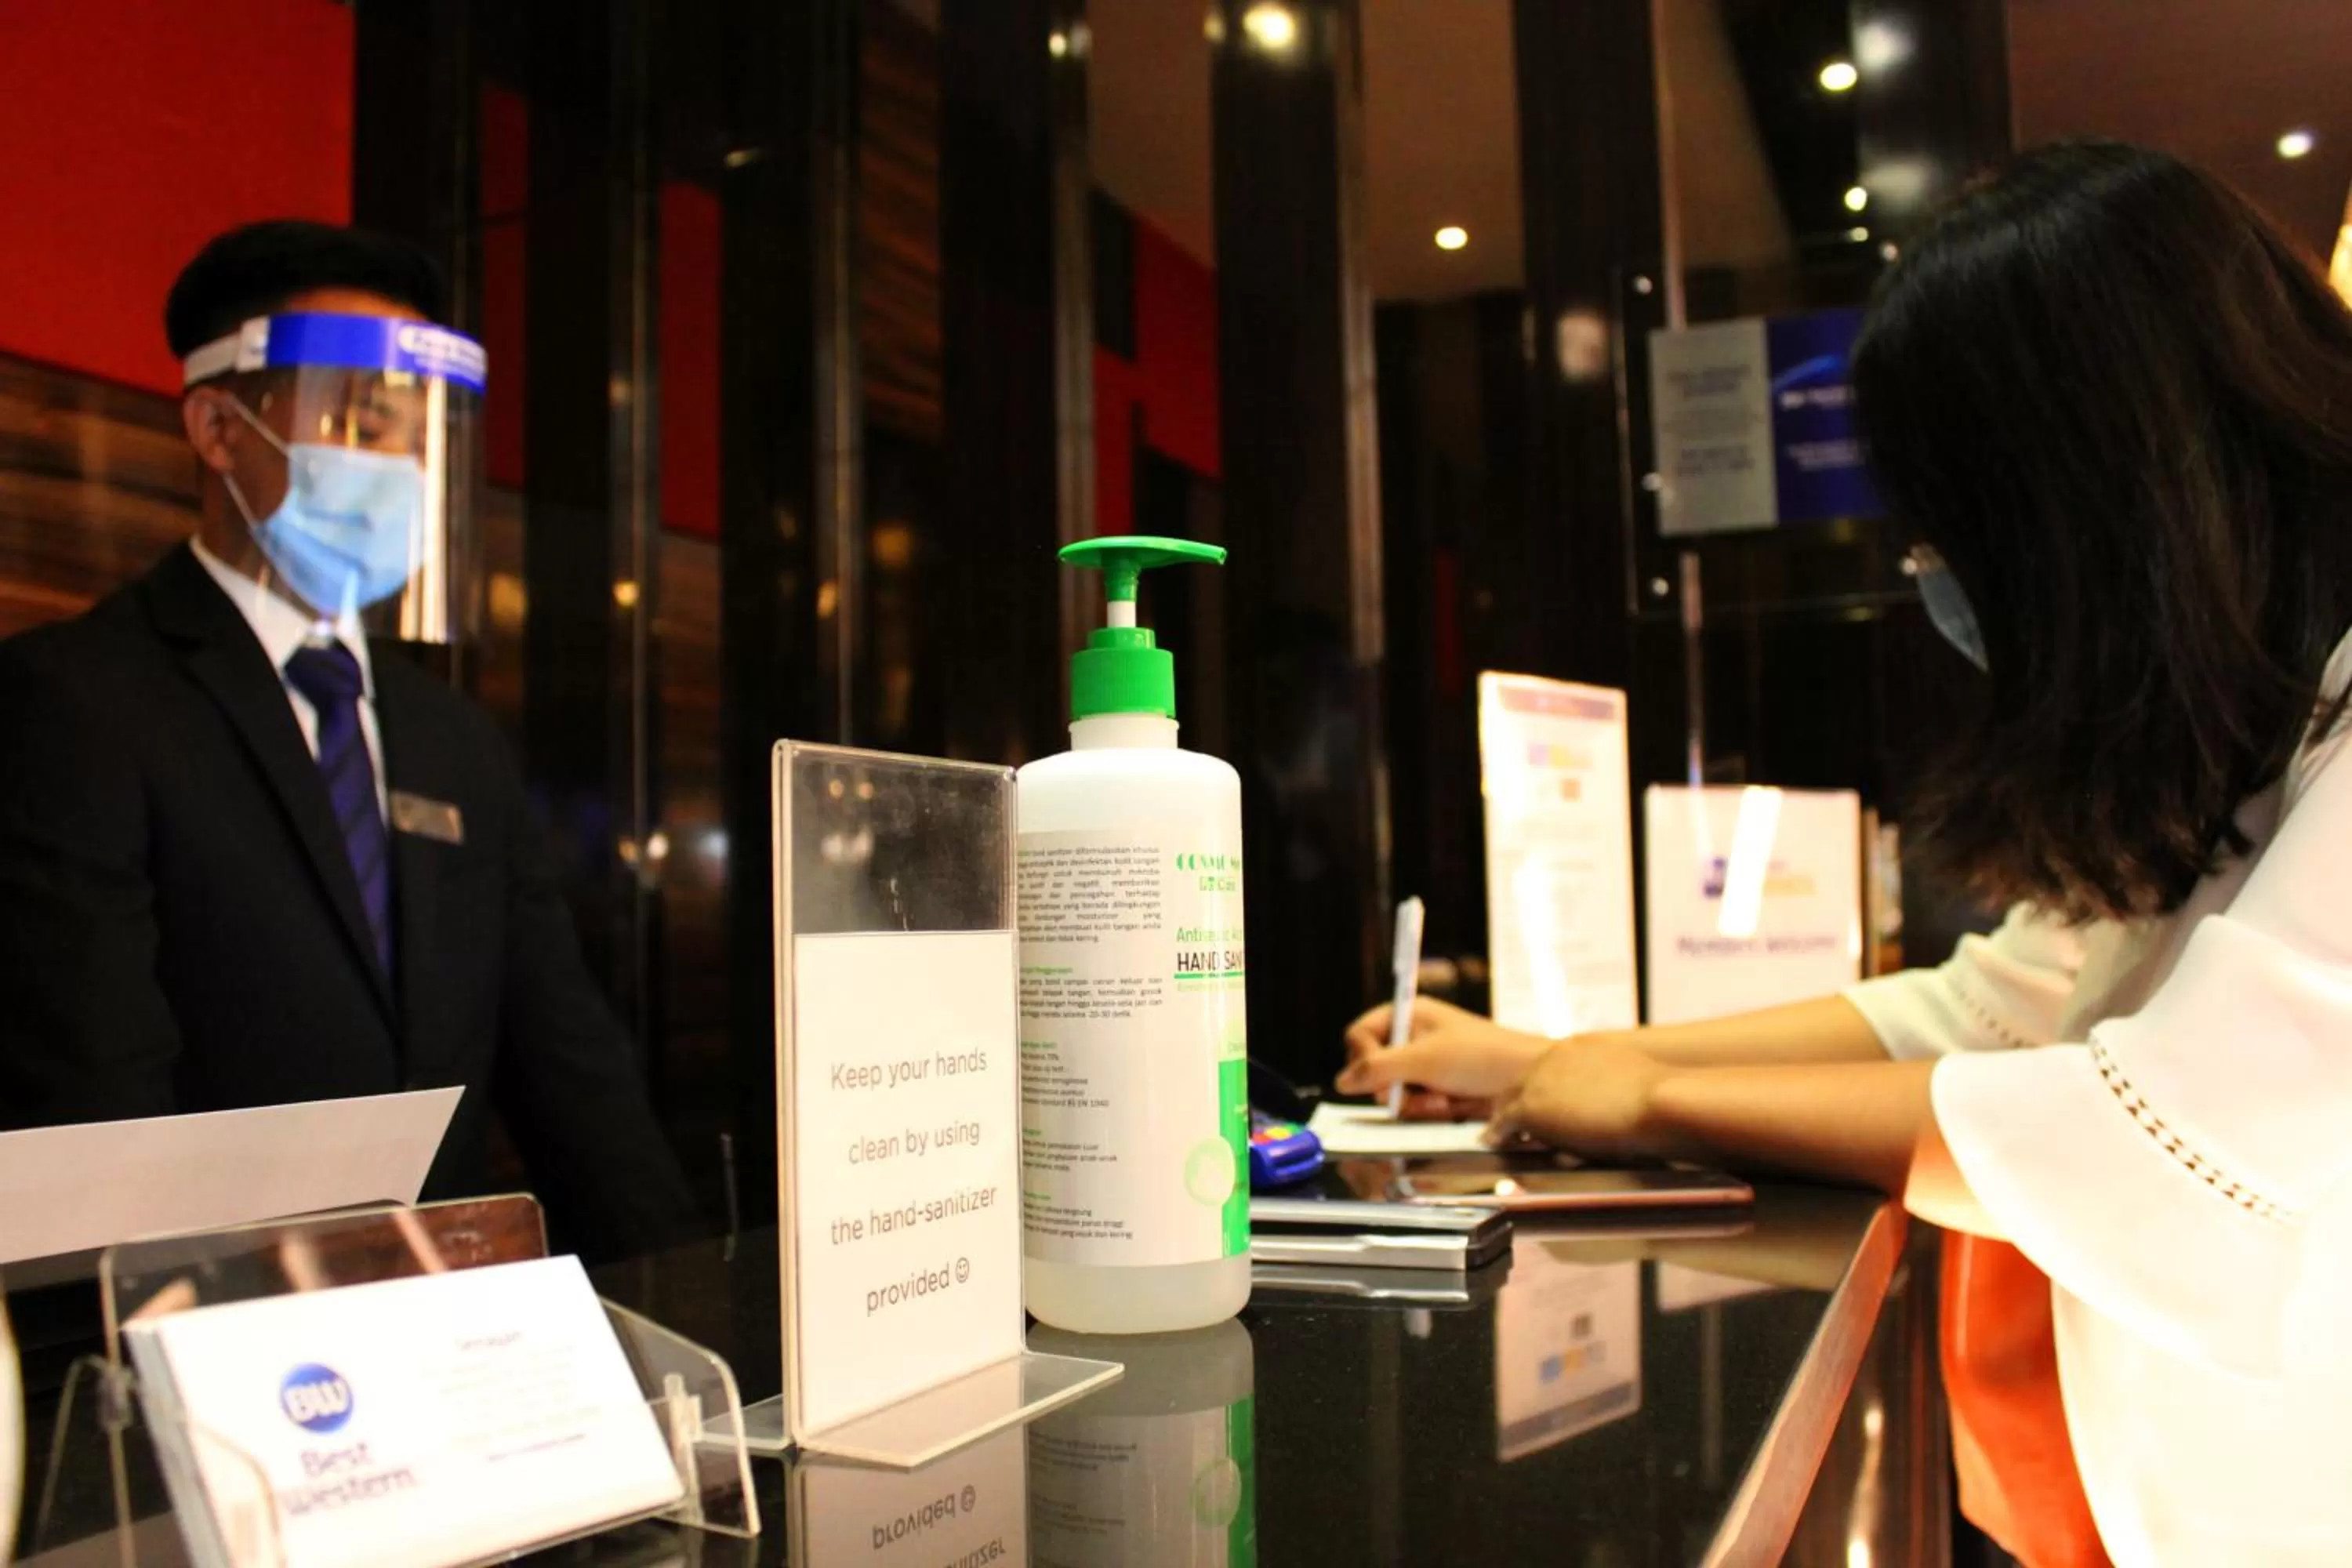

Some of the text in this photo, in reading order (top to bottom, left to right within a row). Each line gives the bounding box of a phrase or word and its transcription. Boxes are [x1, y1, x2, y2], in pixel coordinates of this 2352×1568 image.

[1178, 951, 1220, 971] HAND
[831, 1047, 988, 1091] Keep your hands
[848, 1121, 981, 1164] clean by using
[831, 1186, 997, 1246] the hand-sanitizer
[866, 1262, 950, 1317] provided
